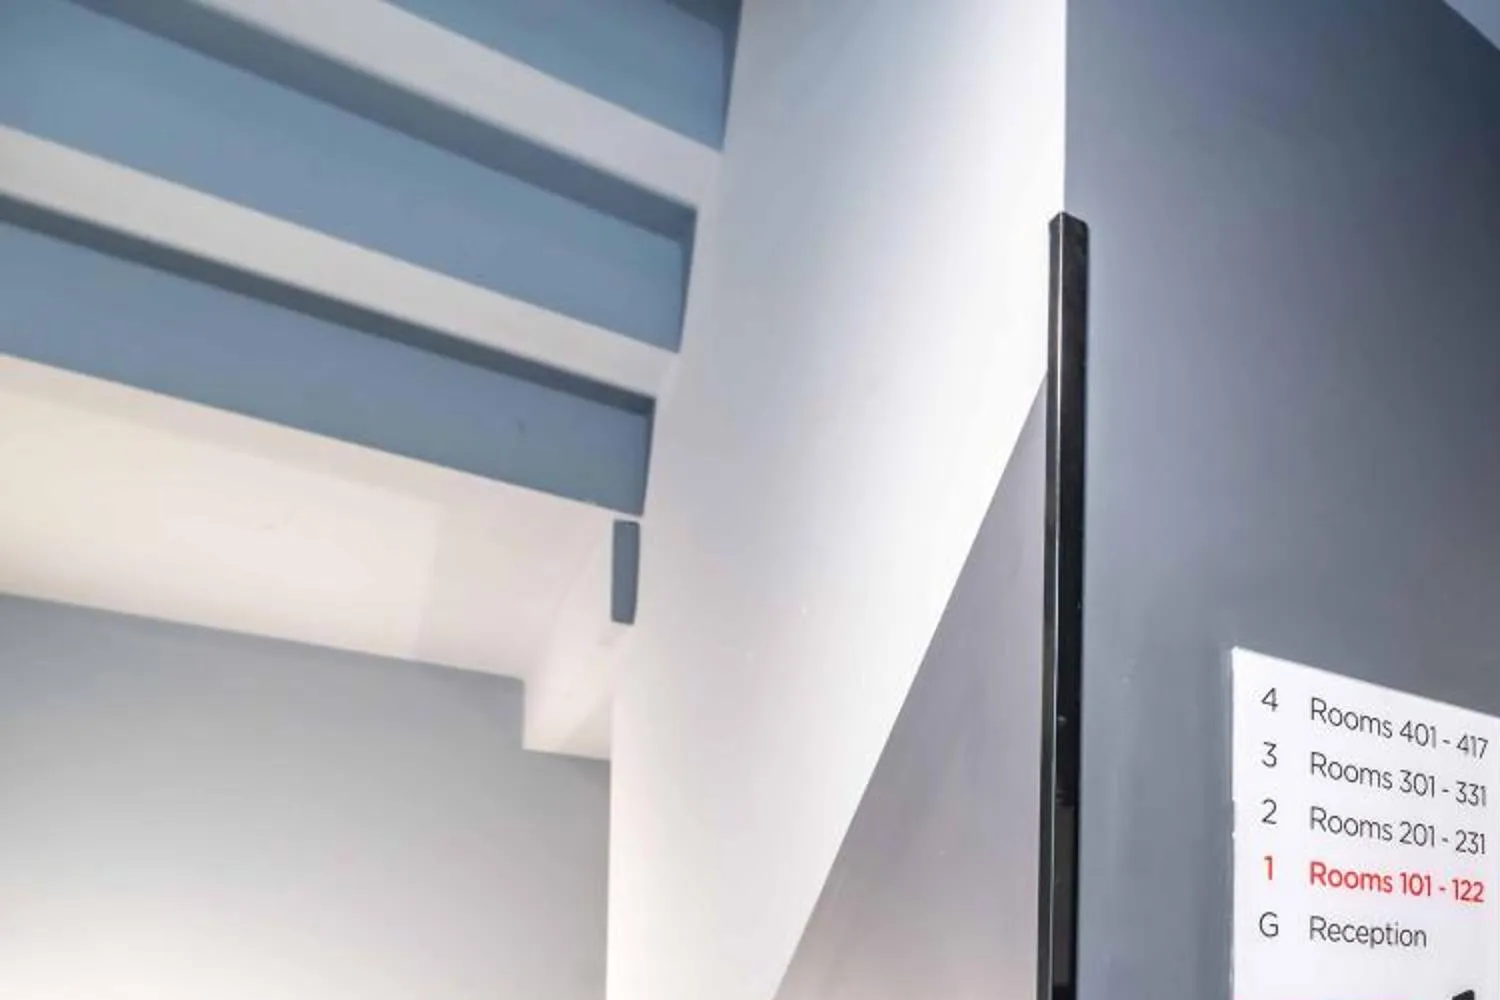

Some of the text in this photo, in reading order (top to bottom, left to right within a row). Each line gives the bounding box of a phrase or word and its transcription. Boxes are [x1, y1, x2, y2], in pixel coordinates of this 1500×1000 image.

[1261, 687, 1279, 712] 4
[1311, 697, 1393, 739] Rooms
[1399, 720, 1437, 749] 401
[1456, 734, 1488, 760] 417
[1261, 742, 1278, 768] 3
[1311, 751, 1393, 790] Rooms
[1399, 769, 1435, 798] 301
[1456, 780, 1487, 807] 331
[1261, 799, 1277, 825] 2
[1310, 805, 1393, 842] Rooms
[1399, 820, 1435, 848] 201
[1456, 829, 1486, 855] 231
[1263, 855, 1274, 881] 1
[1310, 860, 1393, 894] Rooms
[1400, 871, 1432, 897] 101
[1452, 879, 1485, 903] 122
[1259, 911, 1427, 949] G Reception
